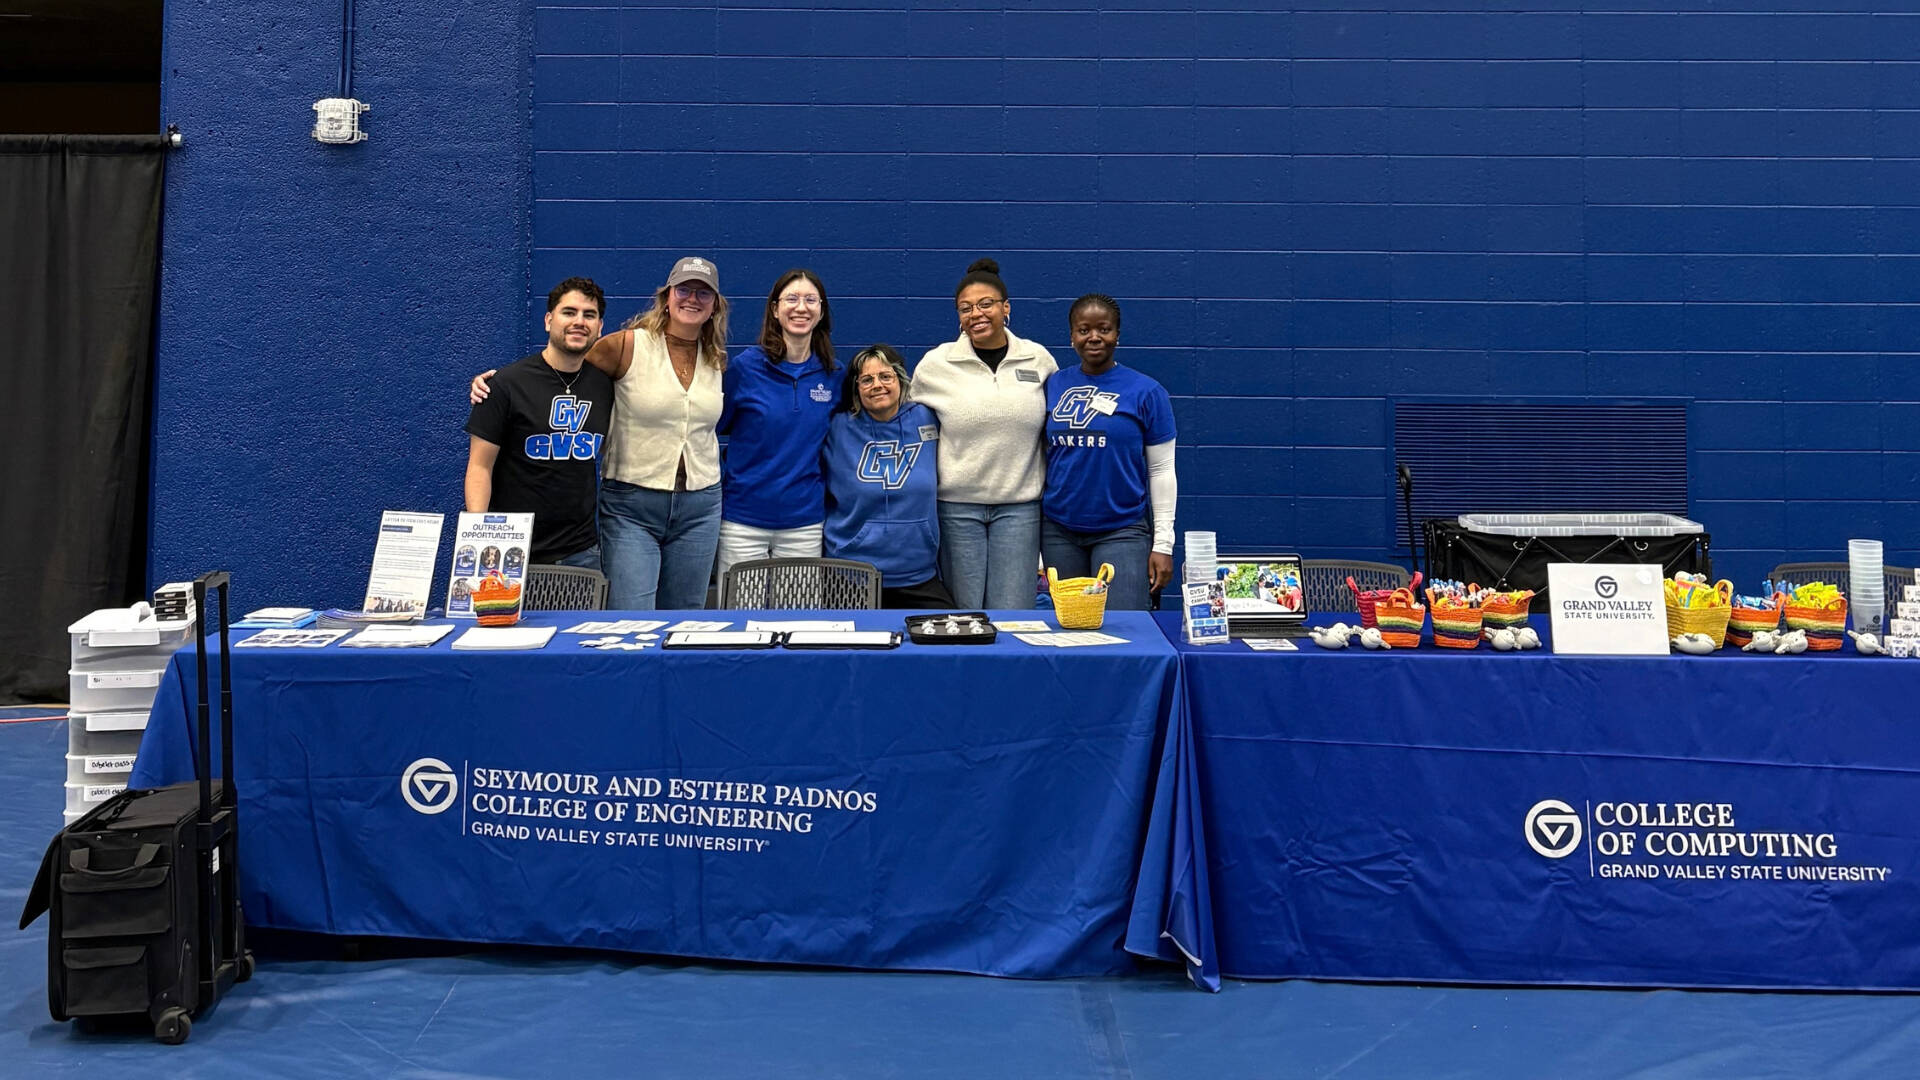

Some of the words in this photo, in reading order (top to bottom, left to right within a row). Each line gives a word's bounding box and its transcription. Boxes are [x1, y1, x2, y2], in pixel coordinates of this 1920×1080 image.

[549, 394, 592, 433] GV
[856, 440, 923, 490] GV
[461, 531, 525, 540] OPPORTUNITIES
[472, 523, 514, 532] OUTREACH
[1563, 600, 1606, 611] GRAND
[1607, 600, 1653, 611] VALLEY
[473, 767, 599, 795] SEYMOUR
[604, 775, 662, 798] AND
[668, 778, 767, 804] ESTHER
[773, 785, 877, 813] PADNOS
[472, 793, 587, 820] COLLEGE
[594, 801, 629, 822] OF
[634, 803, 814, 833] ENGINEERING
[1595, 802, 1735, 827] COLLEGE
[471, 821, 530, 840] GRAND
[535, 827, 601, 845] VALLEY
[604, 831, 659, 847] STATE
[1597, 831, 1637, 856] OF
[1645, 832, 1838, 858] COMPUTING
[1599, 863, 1660, 878] GRAND
[1662, 864, 1726, 879] VALLEY
[1730, 865, 1783, 880] STATE
